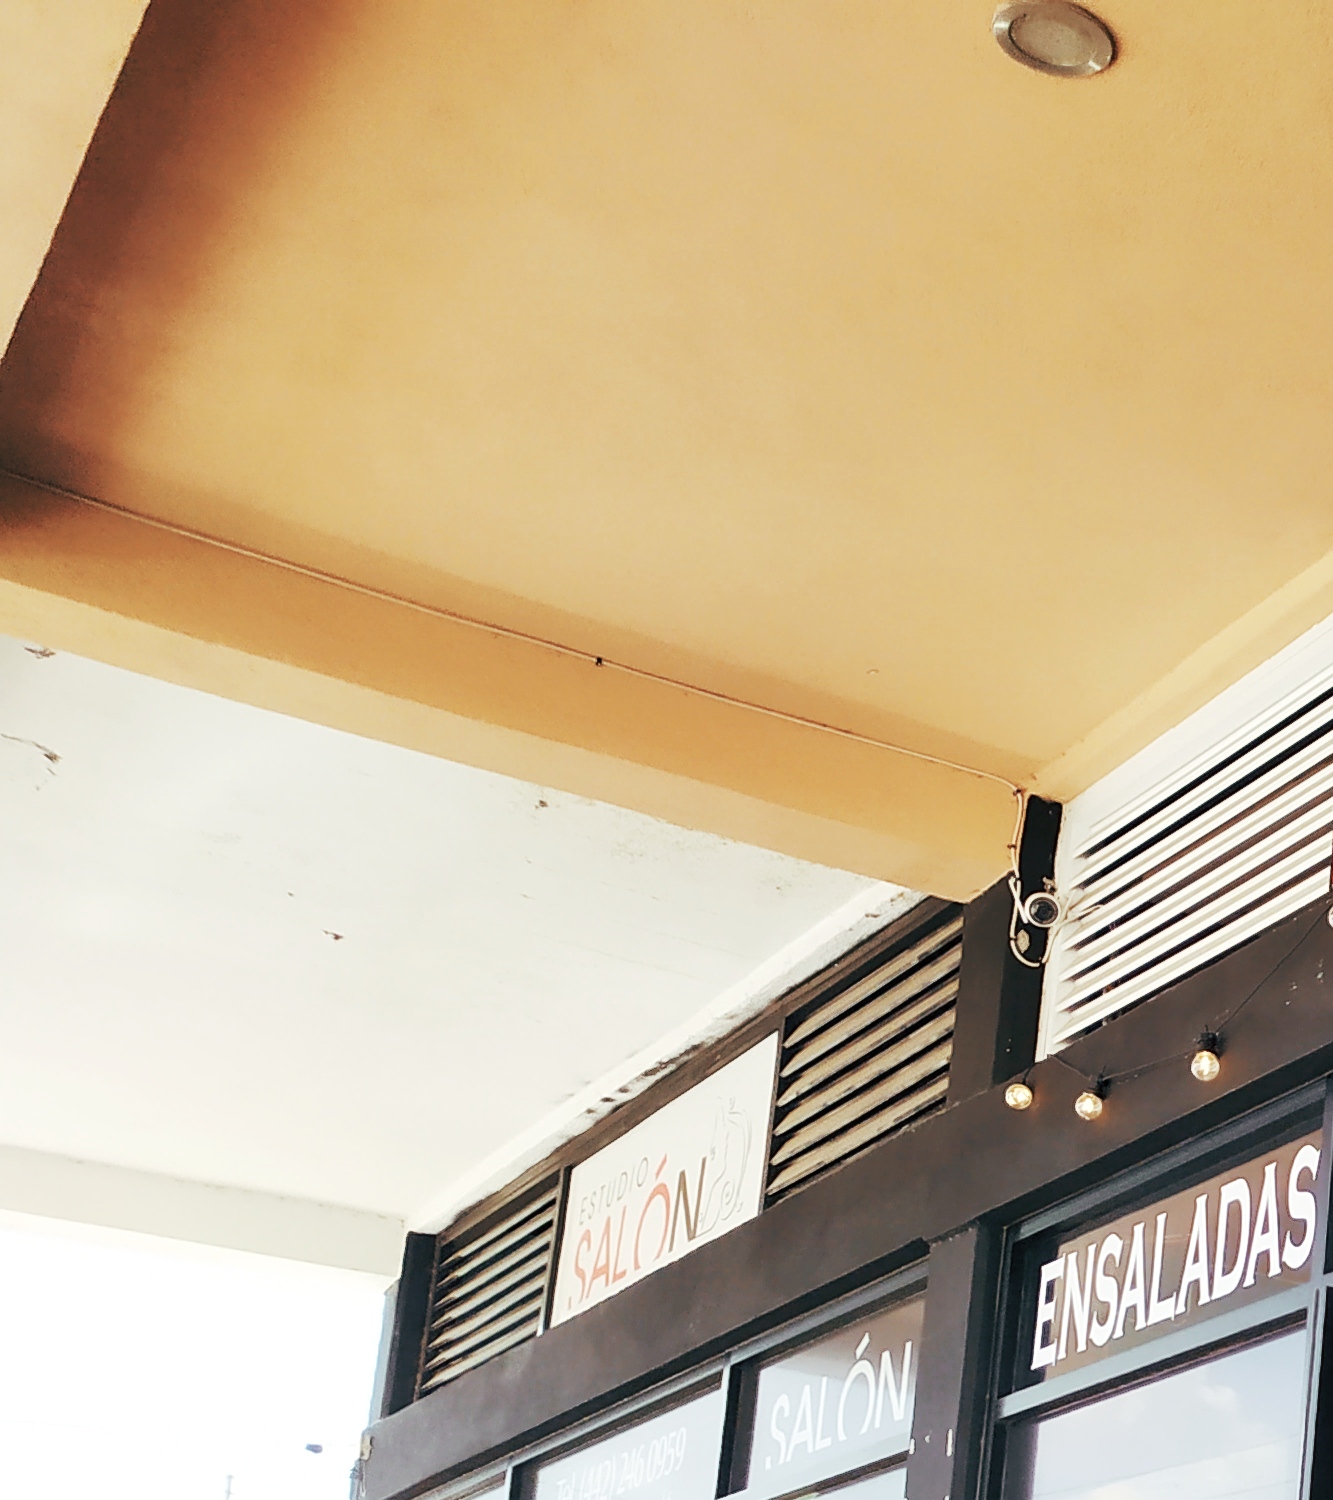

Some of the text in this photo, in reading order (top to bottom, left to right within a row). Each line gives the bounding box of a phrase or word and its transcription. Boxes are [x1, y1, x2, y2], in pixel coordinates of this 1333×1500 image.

[566, 1152, 709, 1312] SALÓN
[577, 1155, 651, 1227] ESTUDIO
[1029, 1140, 1323, 1373] ENSALADAS
[616, 1444, 646, 1495] 246
[646, 1426, 687, 1483] 0959
[763, 1330, 915, 1471] SALÓN
